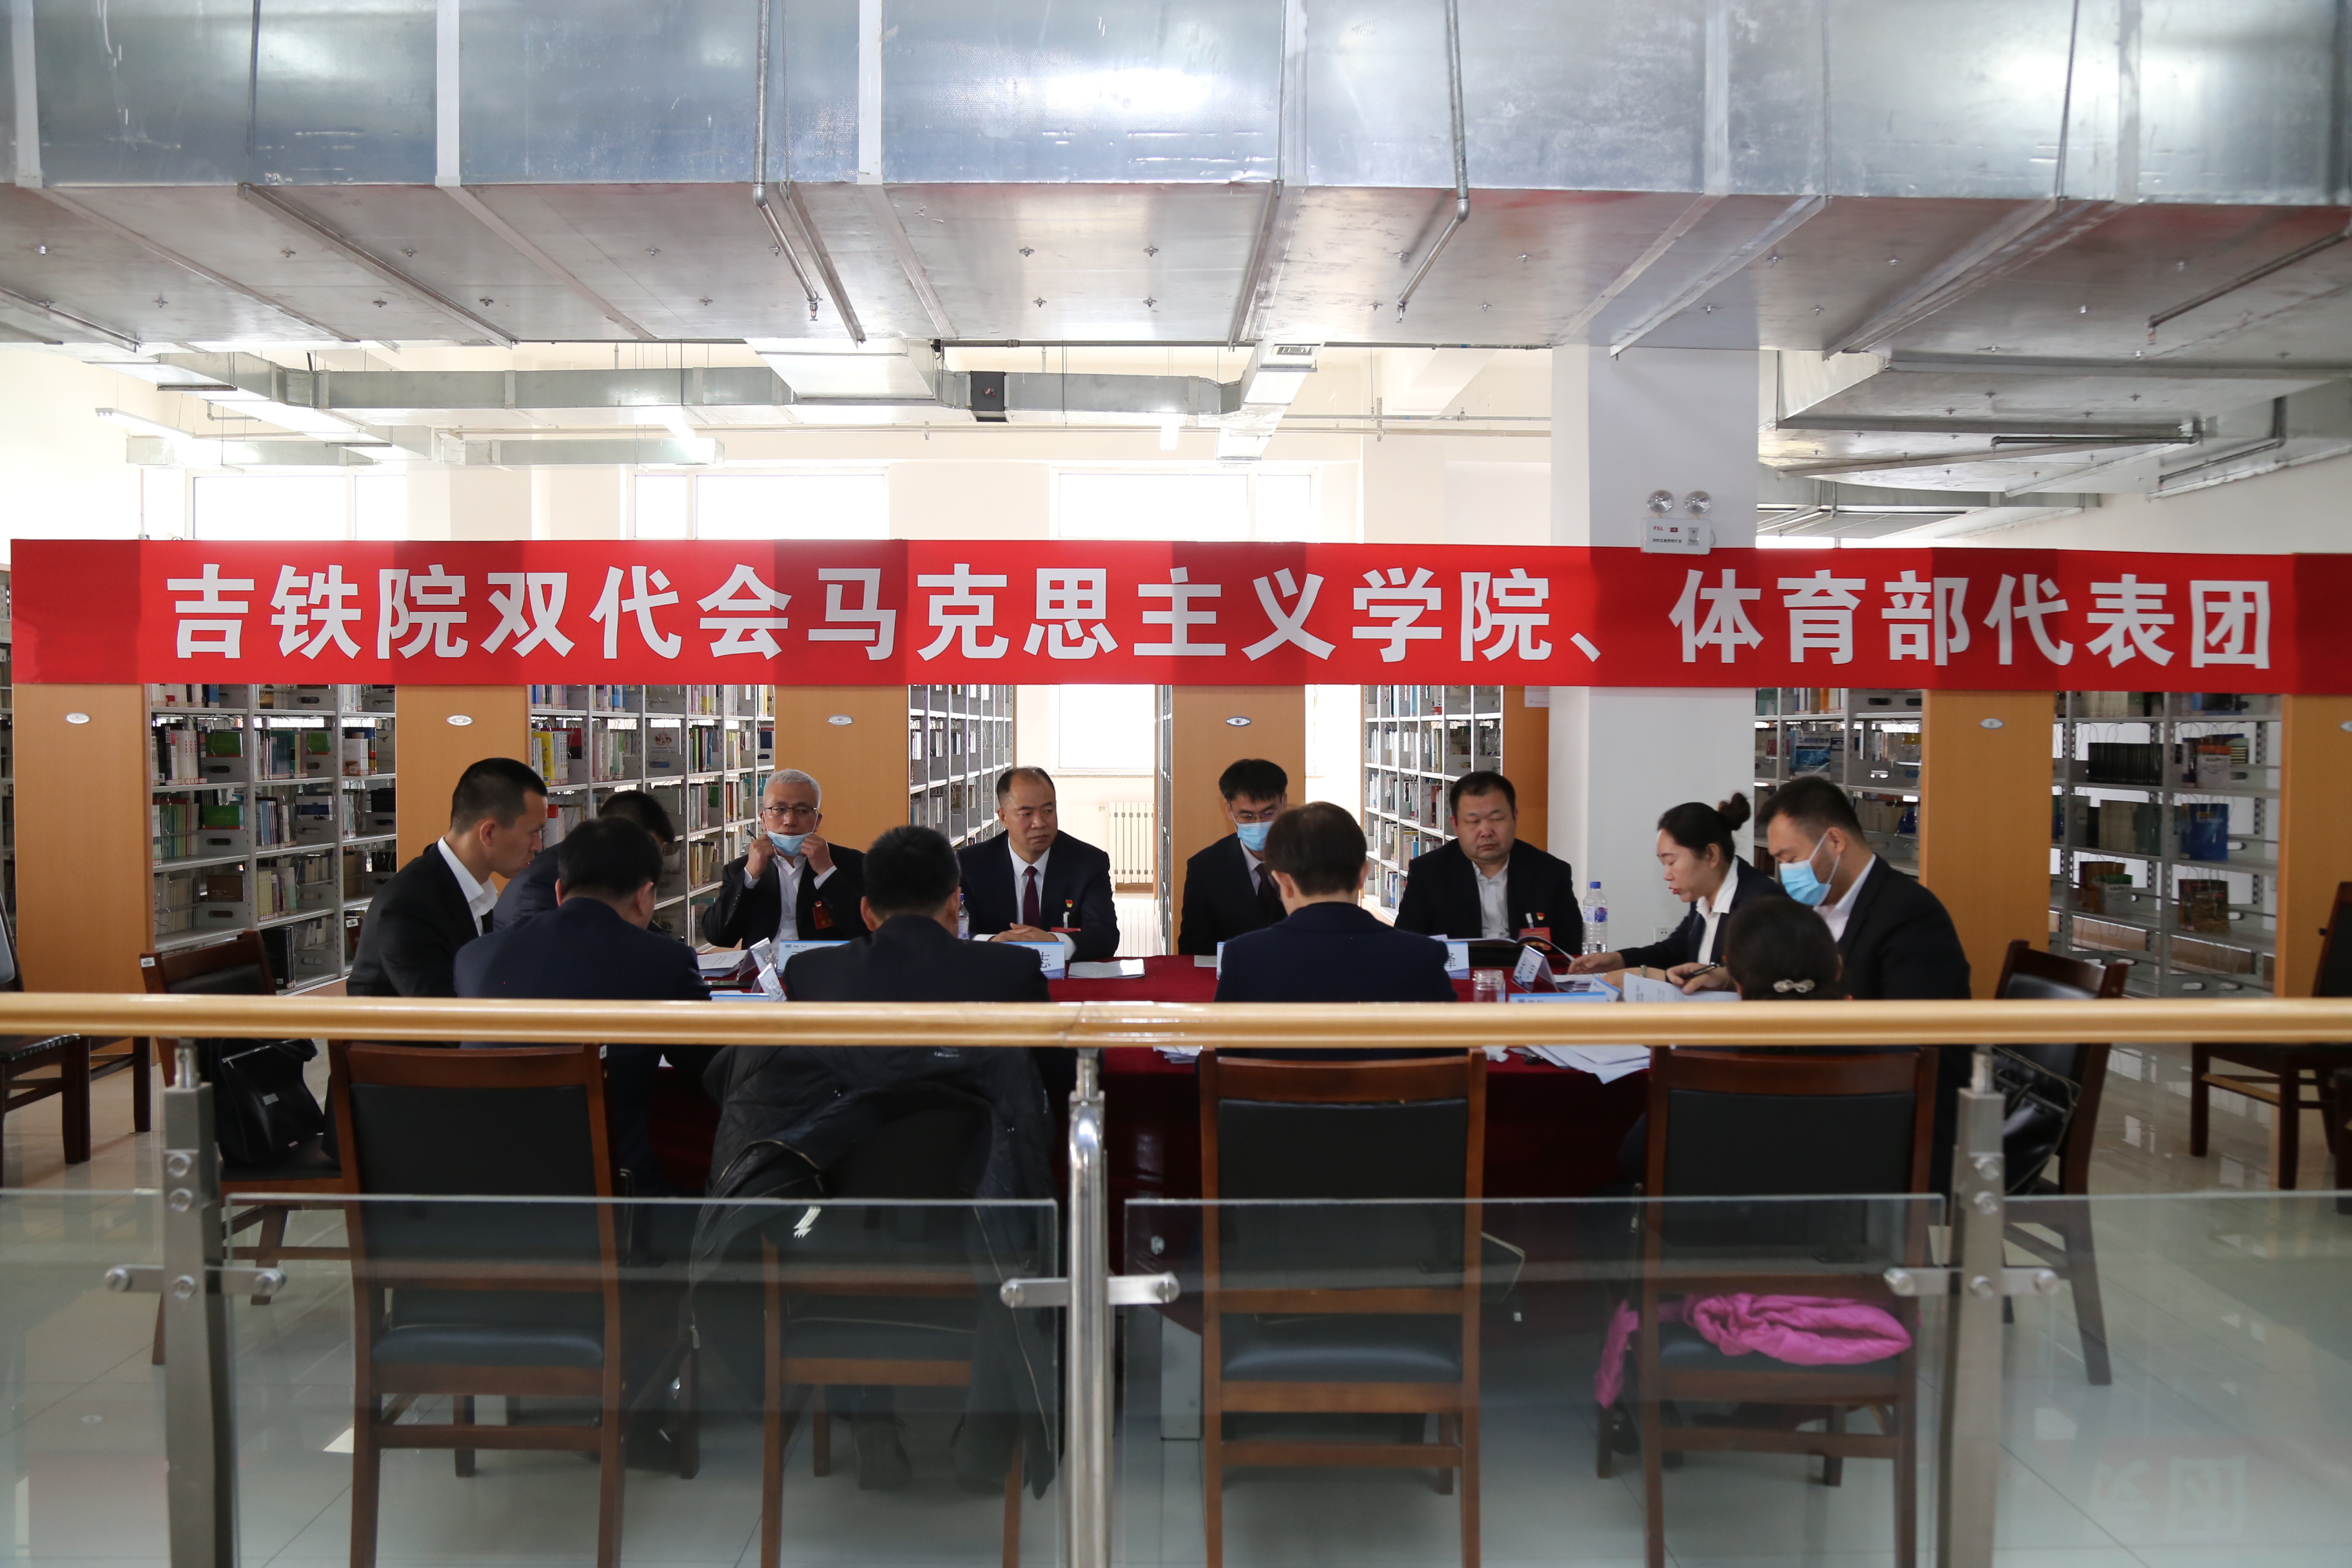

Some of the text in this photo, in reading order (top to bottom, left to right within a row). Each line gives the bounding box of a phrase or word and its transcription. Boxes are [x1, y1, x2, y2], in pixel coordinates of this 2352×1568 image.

[167, 564, 2271, 670] 吉铁院双代会马克思主义学院、体育部代表团
